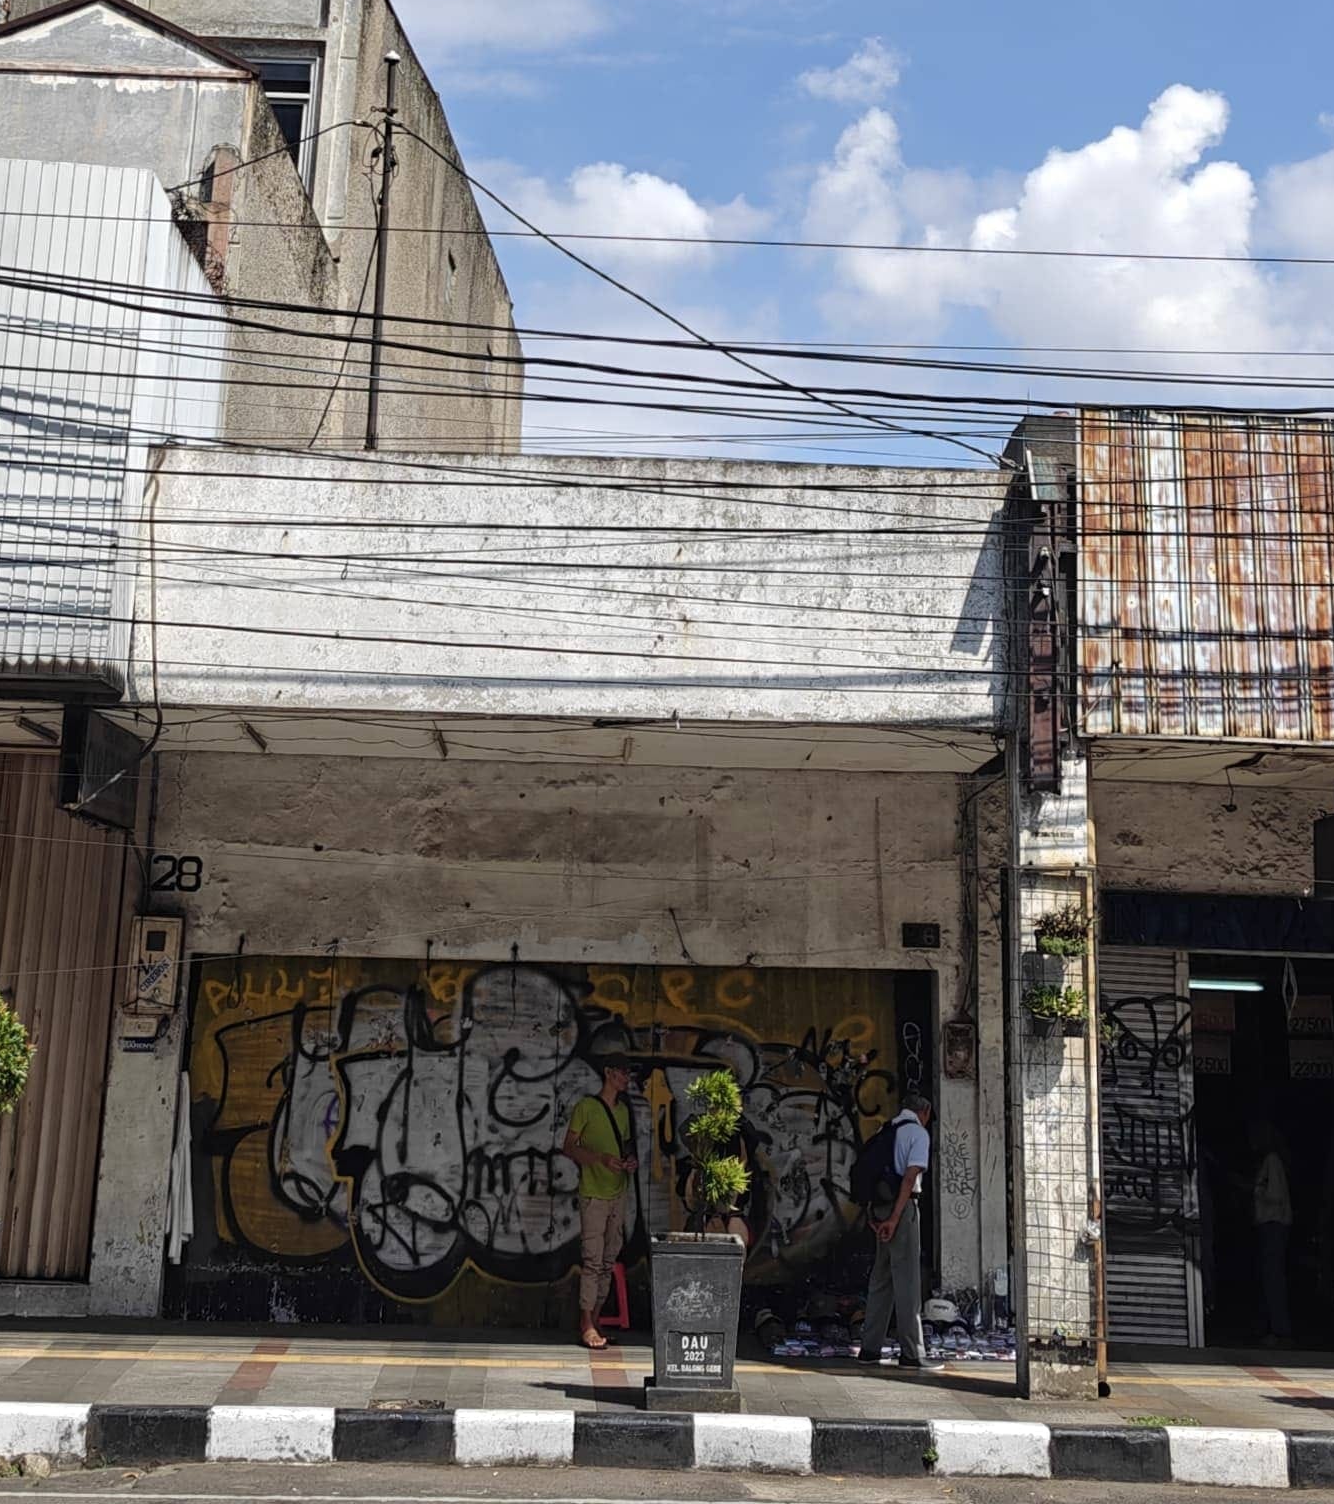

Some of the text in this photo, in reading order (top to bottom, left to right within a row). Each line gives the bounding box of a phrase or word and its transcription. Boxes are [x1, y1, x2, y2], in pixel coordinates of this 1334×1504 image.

[150, 854, 203, 893] 28
[681, 1336, 709, 1350] DAU
[684, 1351, 706, 1362] 2023
